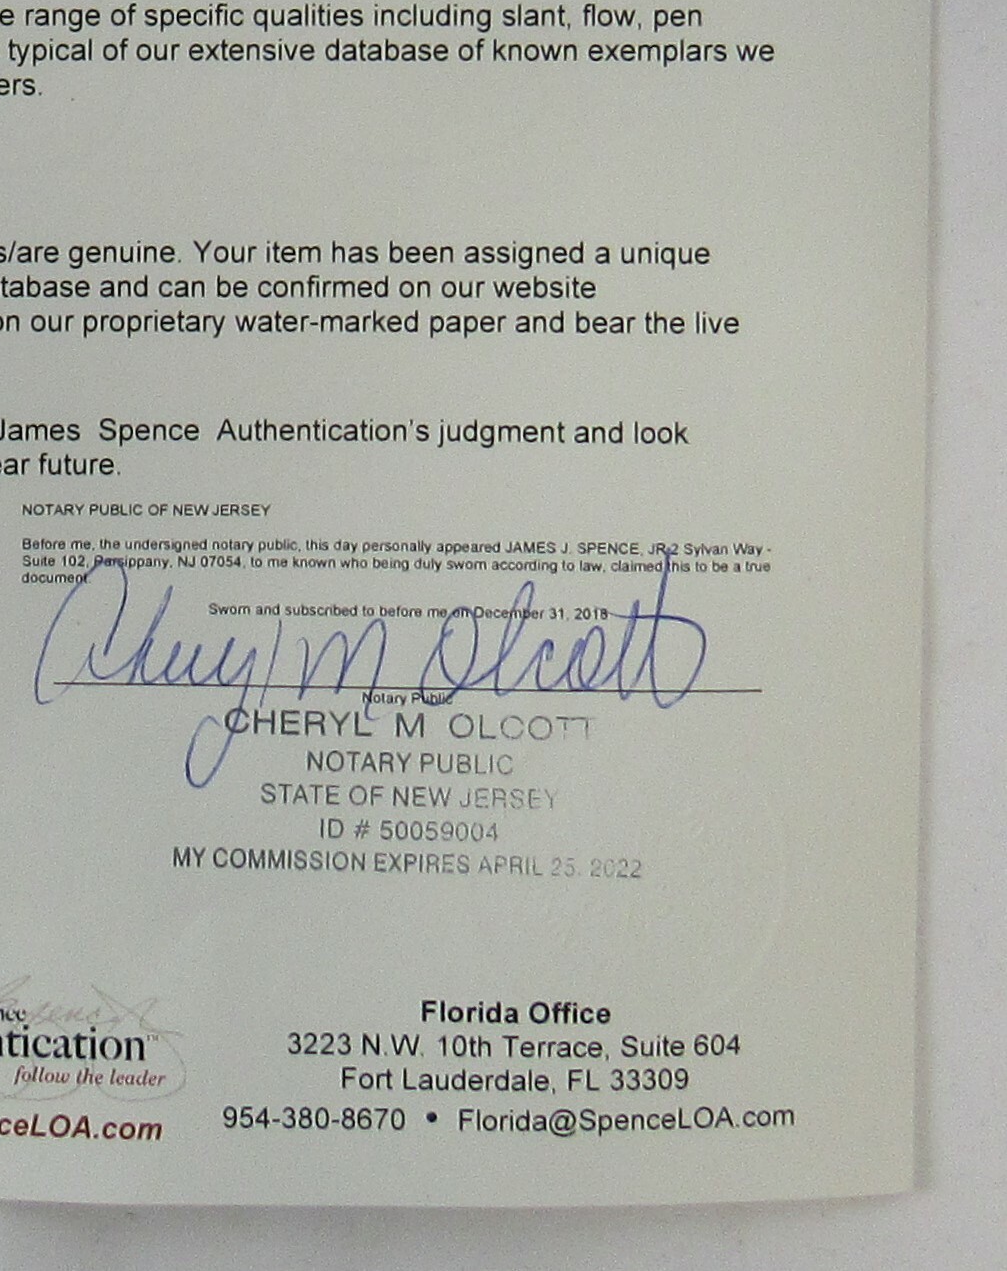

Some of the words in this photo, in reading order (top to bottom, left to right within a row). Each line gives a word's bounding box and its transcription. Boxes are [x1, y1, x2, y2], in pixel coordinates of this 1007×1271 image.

[21, 502, 85, 516] NOTARY
[88, 502, 143, 517] PUBLIC
[147, 502, 169, 517] OF
[172, 503, 210, 517] NEW
[211, 503, 271, 517] JERSEY
[21, 537, 66, 551] Before
[98, 537, 121, 550] the
[124, 538, 208, 554] undersigned
[211, 538, 254, 553] notary
[305, 538, 329, 551] this
[332, 538, 358, 554] day
[361, 539, 432, 555] personally
[435, 541, 501, 556] appeared
[504, 540, 557, 554] JAMES
[683, 542, 729, 558] Sylvan
[732, 542, 763, 557] Way
[223, 708, 374, 737] CHERYL
[395, 711, 425, 738] M
[448, 712, 591, 742] OLCOTT
[306, 749, 412, 774] NOTARY
[419, 752, 514, 776] PUBLIC
[260, 782, 340, 806] STATE
[348, 784, 384, 807] OF
[392, 785, 451, 808] NEW
[459, 787, 558, 810] JERSEY
[319, 817, 345, 839] ID
[353, 818, 371, 839] #
[379, 819, 499, 842] 50059004
[172, 845, 206, 868] MY
[212, 846, 366, 872] COMMISSION
[373, 852, 470, 874] EXPIRES
[478, 854, 543, 876] APRIL
[590, 858, 642, 879] 2022
[421, 999, 519, 1024] Florida
[528, 1000, 611, 1025] Office
[287, 1031, 352, 1056] 3223
[361, 1032, 426, 1057] N.W.
[438, 1034, 492, 1058] 10th
[501, 1034, 609, 1061] Terrace,
[620, 1034, 685, 1058] Suite
[693, 1033, 741, 1057] 604
[13, 1064, 70, 1085] follow
[75, 1067, 104, 1085] the
[109, 1068, 166, 1087] leader
[341, 1066, 393, 1090] Fort
[402, 1067, 556, 1095] Lauderdale,
[567, 1068, 600, 1092] FL
[609, 1067, 689, 1092] 33309
[222, 1105, 406, 1131] 954-380-8670
[458, 1105, 795, 1138] Florida@SpenceLOA.com
